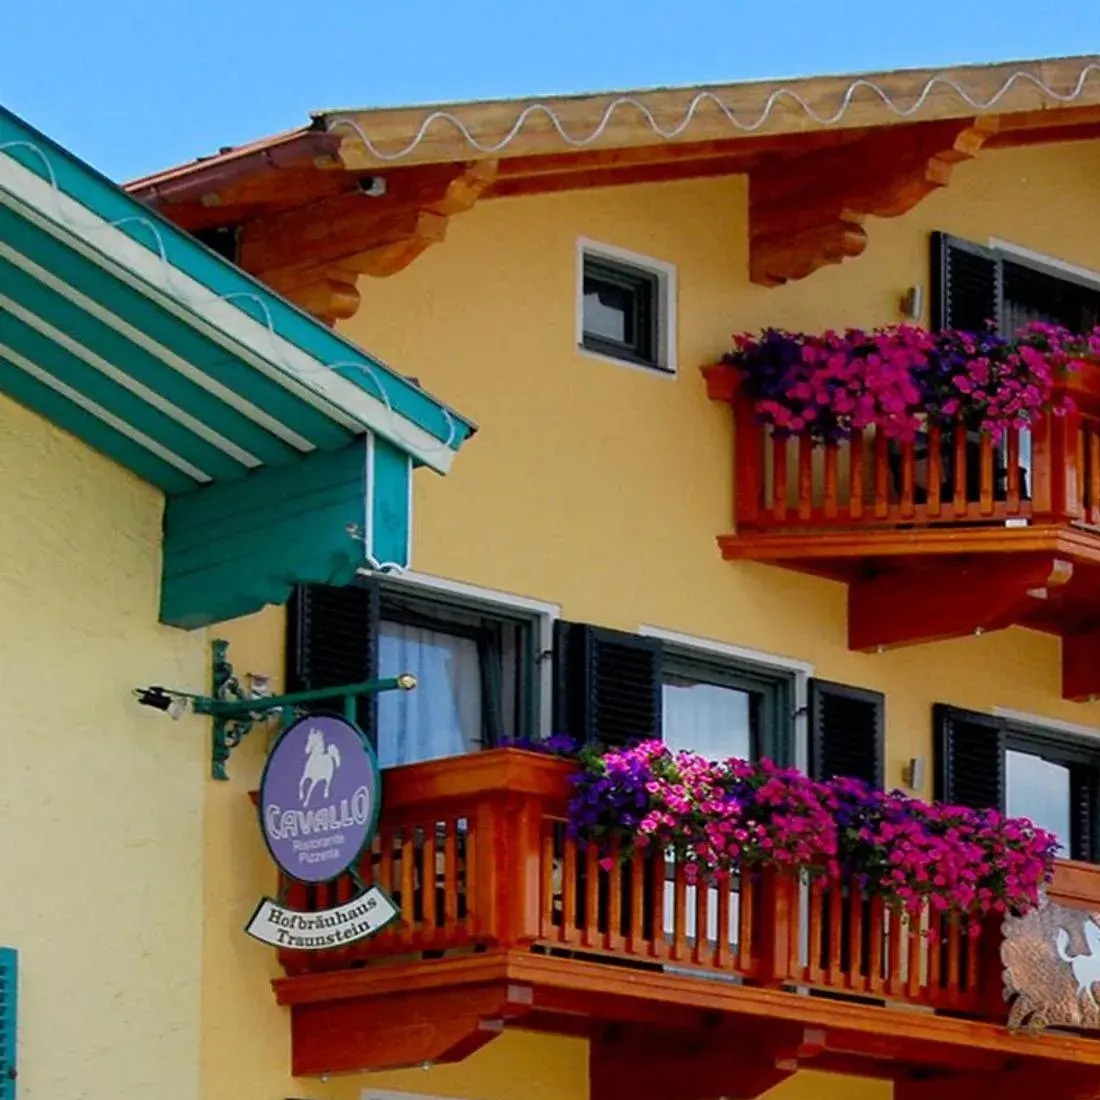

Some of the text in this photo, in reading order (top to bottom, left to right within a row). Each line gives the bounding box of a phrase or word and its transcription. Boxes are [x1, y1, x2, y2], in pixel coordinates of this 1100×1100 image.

[265, 785, 370, 840] CAVALLO
[267, 896, 378, 931] Hofbräuhaus
[276, 920, 371, 947] Traunstein
